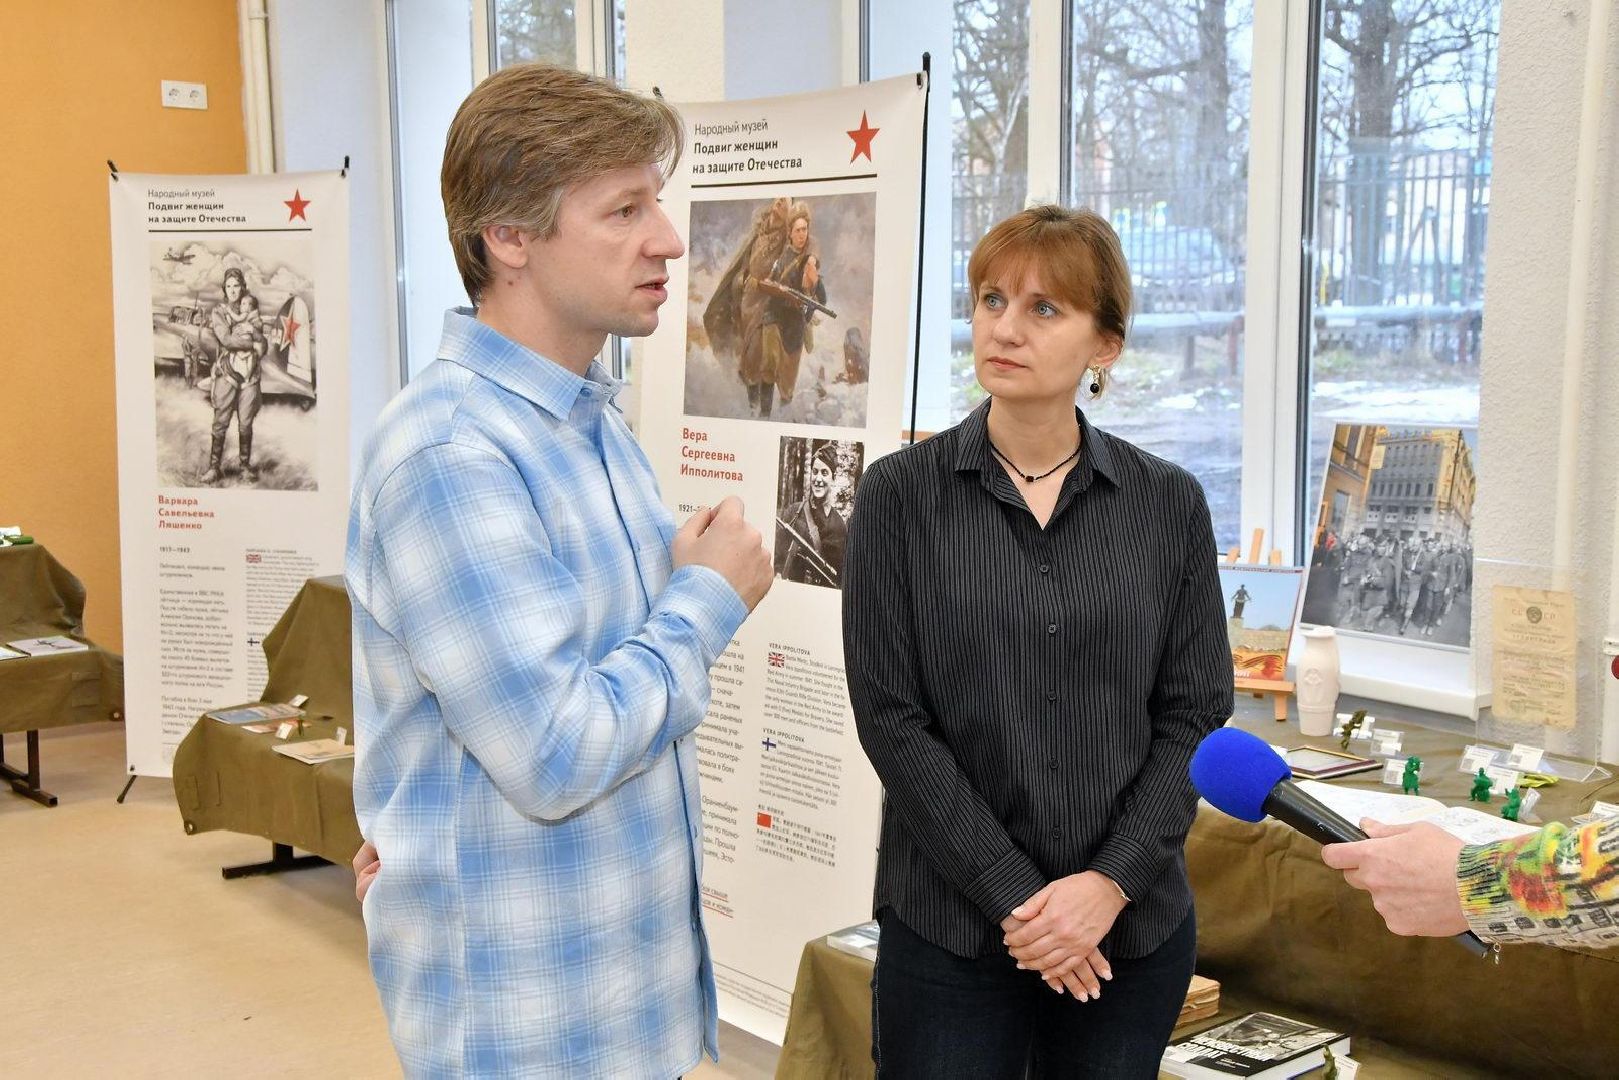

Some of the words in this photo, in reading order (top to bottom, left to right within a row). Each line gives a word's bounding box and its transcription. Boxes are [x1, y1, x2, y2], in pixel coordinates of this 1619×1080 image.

[694, 121, 740, 136] Народный
[742, 118, 769, 134] музей
[694, 142, 731, 155] Подвиг
[734, 140, 778, 152] женщин
[692, 164, 705, 174] на
[708, 161, 744, 174] защите
[747, 157, 802, 171] Отечества
[148, 189, 190, 199] Народный
[191, 188, 216, 199] музей
[148, 202, 184, 212] Подвиг
[185, 202, 225, 212] женщин
[162, 215, 197, 224] защите
[198, 214, 247, 223] Отечества
[682, 428, 708, 443] Вера
[681, 446, 736, 462] Сергеевна
[680, 463, 744, 482] Ипполитова
[158, 495, 199, 506] Варвара
[158, 508, 215, 518] Савельевна
[158, 520, 203, 530] Ляшенко
